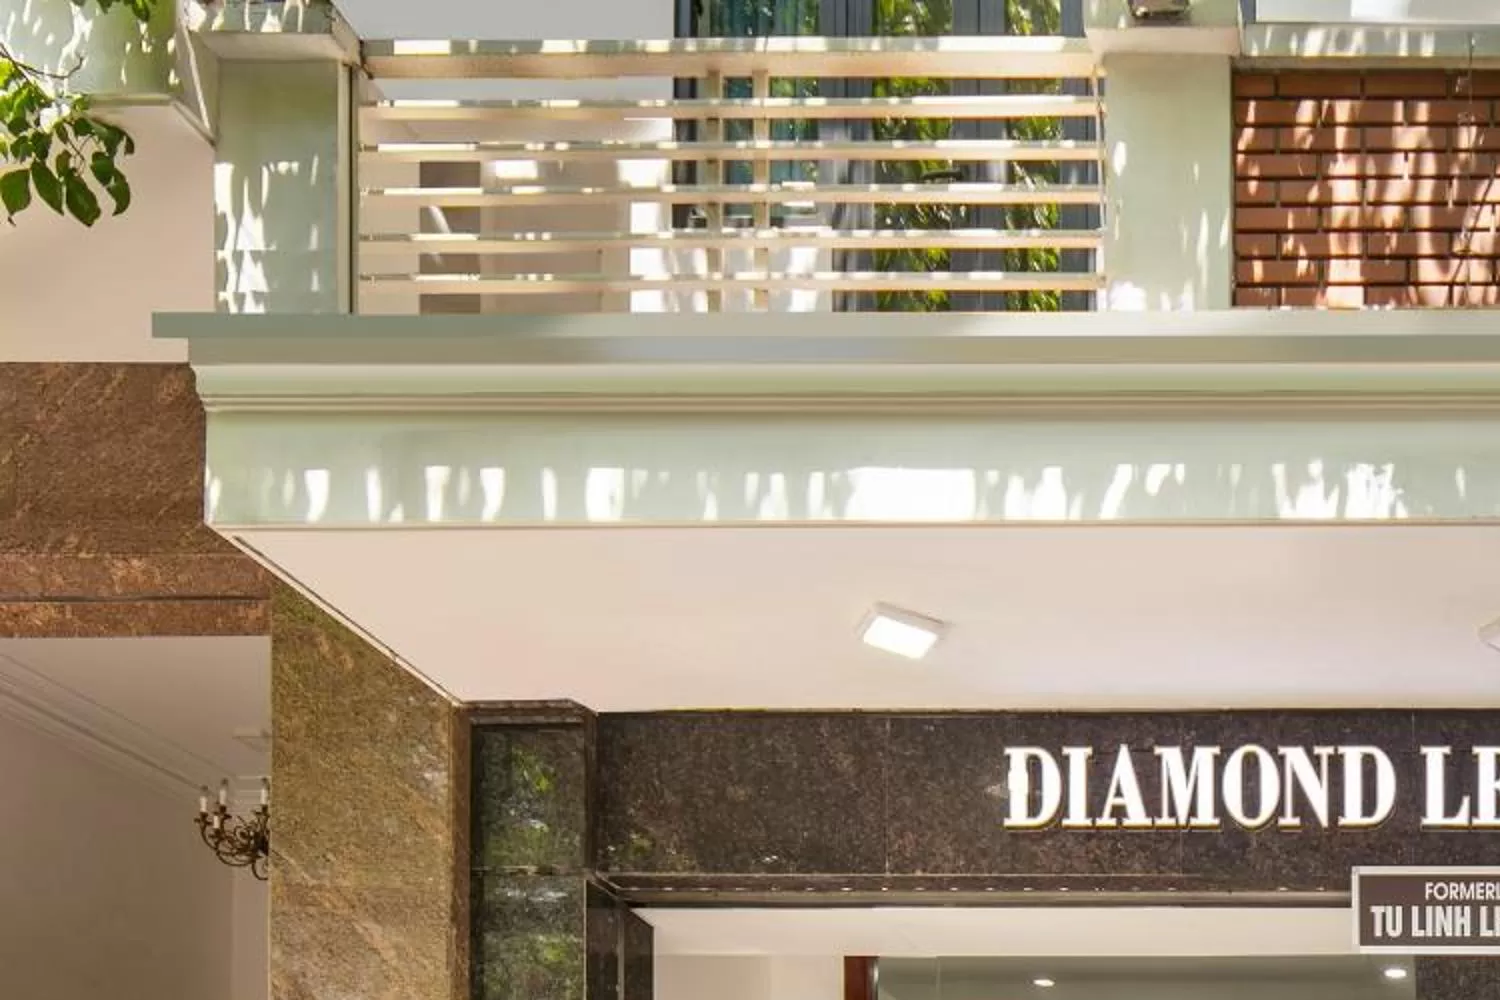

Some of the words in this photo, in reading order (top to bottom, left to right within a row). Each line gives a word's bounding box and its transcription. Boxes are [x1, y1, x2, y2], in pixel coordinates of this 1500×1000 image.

[1004, 744, 1397, 830] DIAMOND
[1370, 905, 1403, 937] TU
[1411, 905, 1471, 937] LINH
